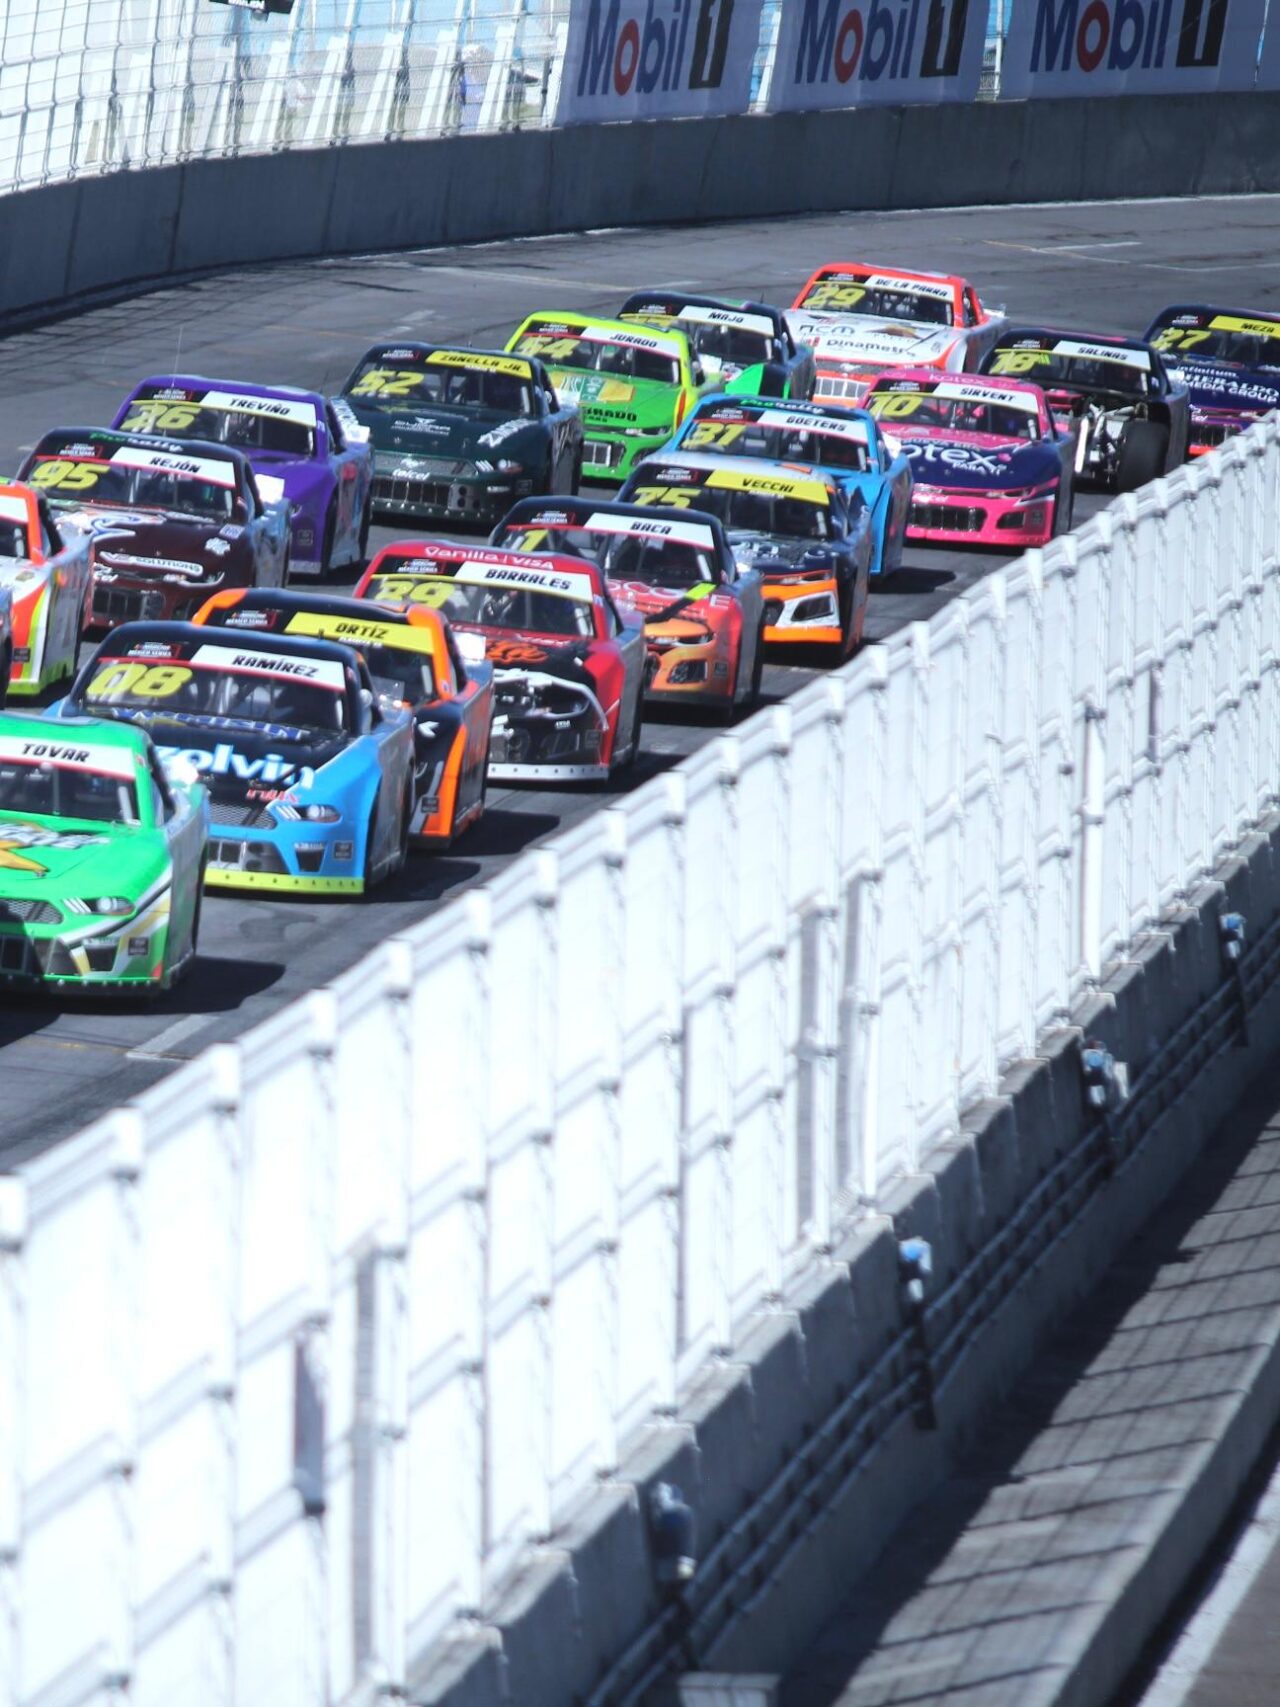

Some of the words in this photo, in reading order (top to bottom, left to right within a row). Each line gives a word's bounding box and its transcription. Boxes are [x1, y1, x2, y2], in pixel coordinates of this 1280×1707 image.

[576, 0, 692, 97] Mobil
[793, 0, 920, 85] Mobil
[1028, 0, 1173, 73] Mobil
[900, 443, 1002, 474] otex
[31, 460, 111, 491] 95
[741, 477, 796, 494] VECCHI
[629, 520, 673, 535] BACA
[511, 556, 556, 571] VISA
[484, 567, 574, 591] BARRALES
[334, 621, 389, 639] ORTÍZ
[230, 653, 321, 679] RAMÍREZ
[86, 663, 193, 698] 08
[21, 742, 91, 763] TOVAR
